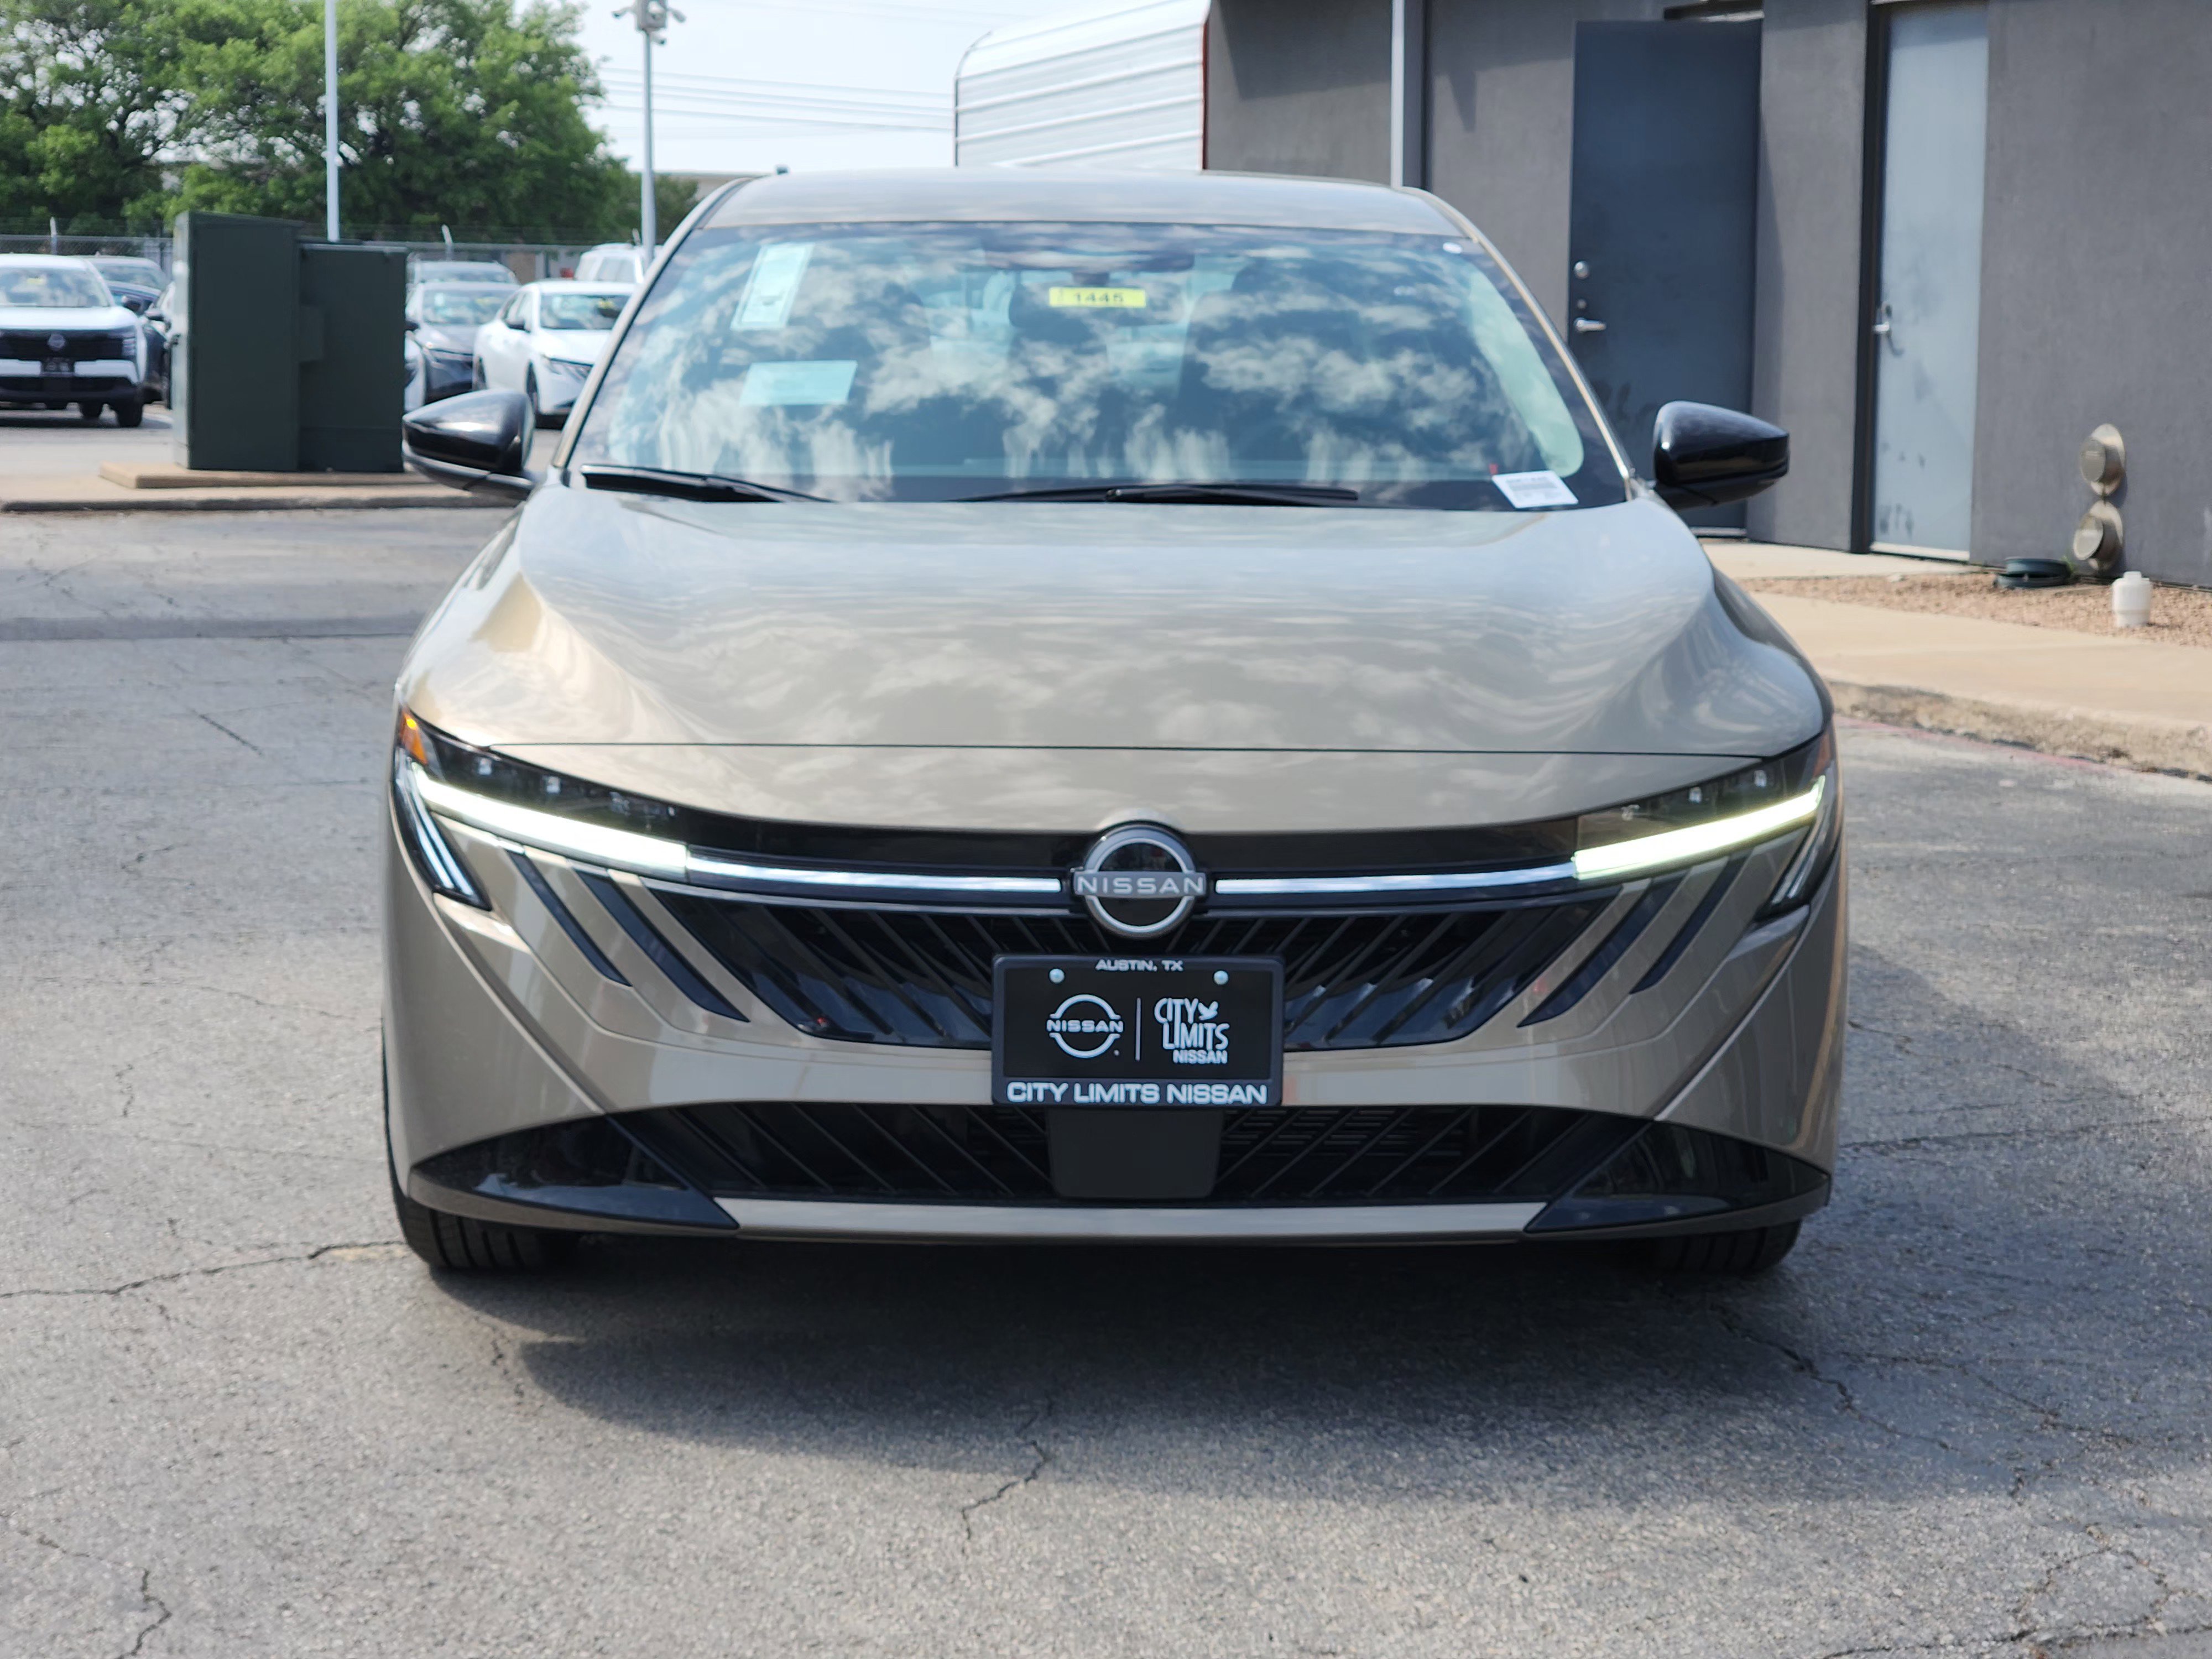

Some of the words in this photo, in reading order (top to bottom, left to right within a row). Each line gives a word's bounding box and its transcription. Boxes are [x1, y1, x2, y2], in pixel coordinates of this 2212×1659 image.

[1077, 877, 1204, 894] NISSAN
[1162, 960, 1183, 971] TX
[1154, 998, 1199, 1024] CITY
[1046, 1019, 1124, 1033] NISSAN
[1162, 1022, 1230, 1050] LIMITS
[1173, 1050, 1228, 1064] NISSAN
[1006, 1082, 1069, 1102] CITY
[1073, 1082, 1160, 1103] LIMITS
[1166, 1084, 1267, 1104] NISSAN
